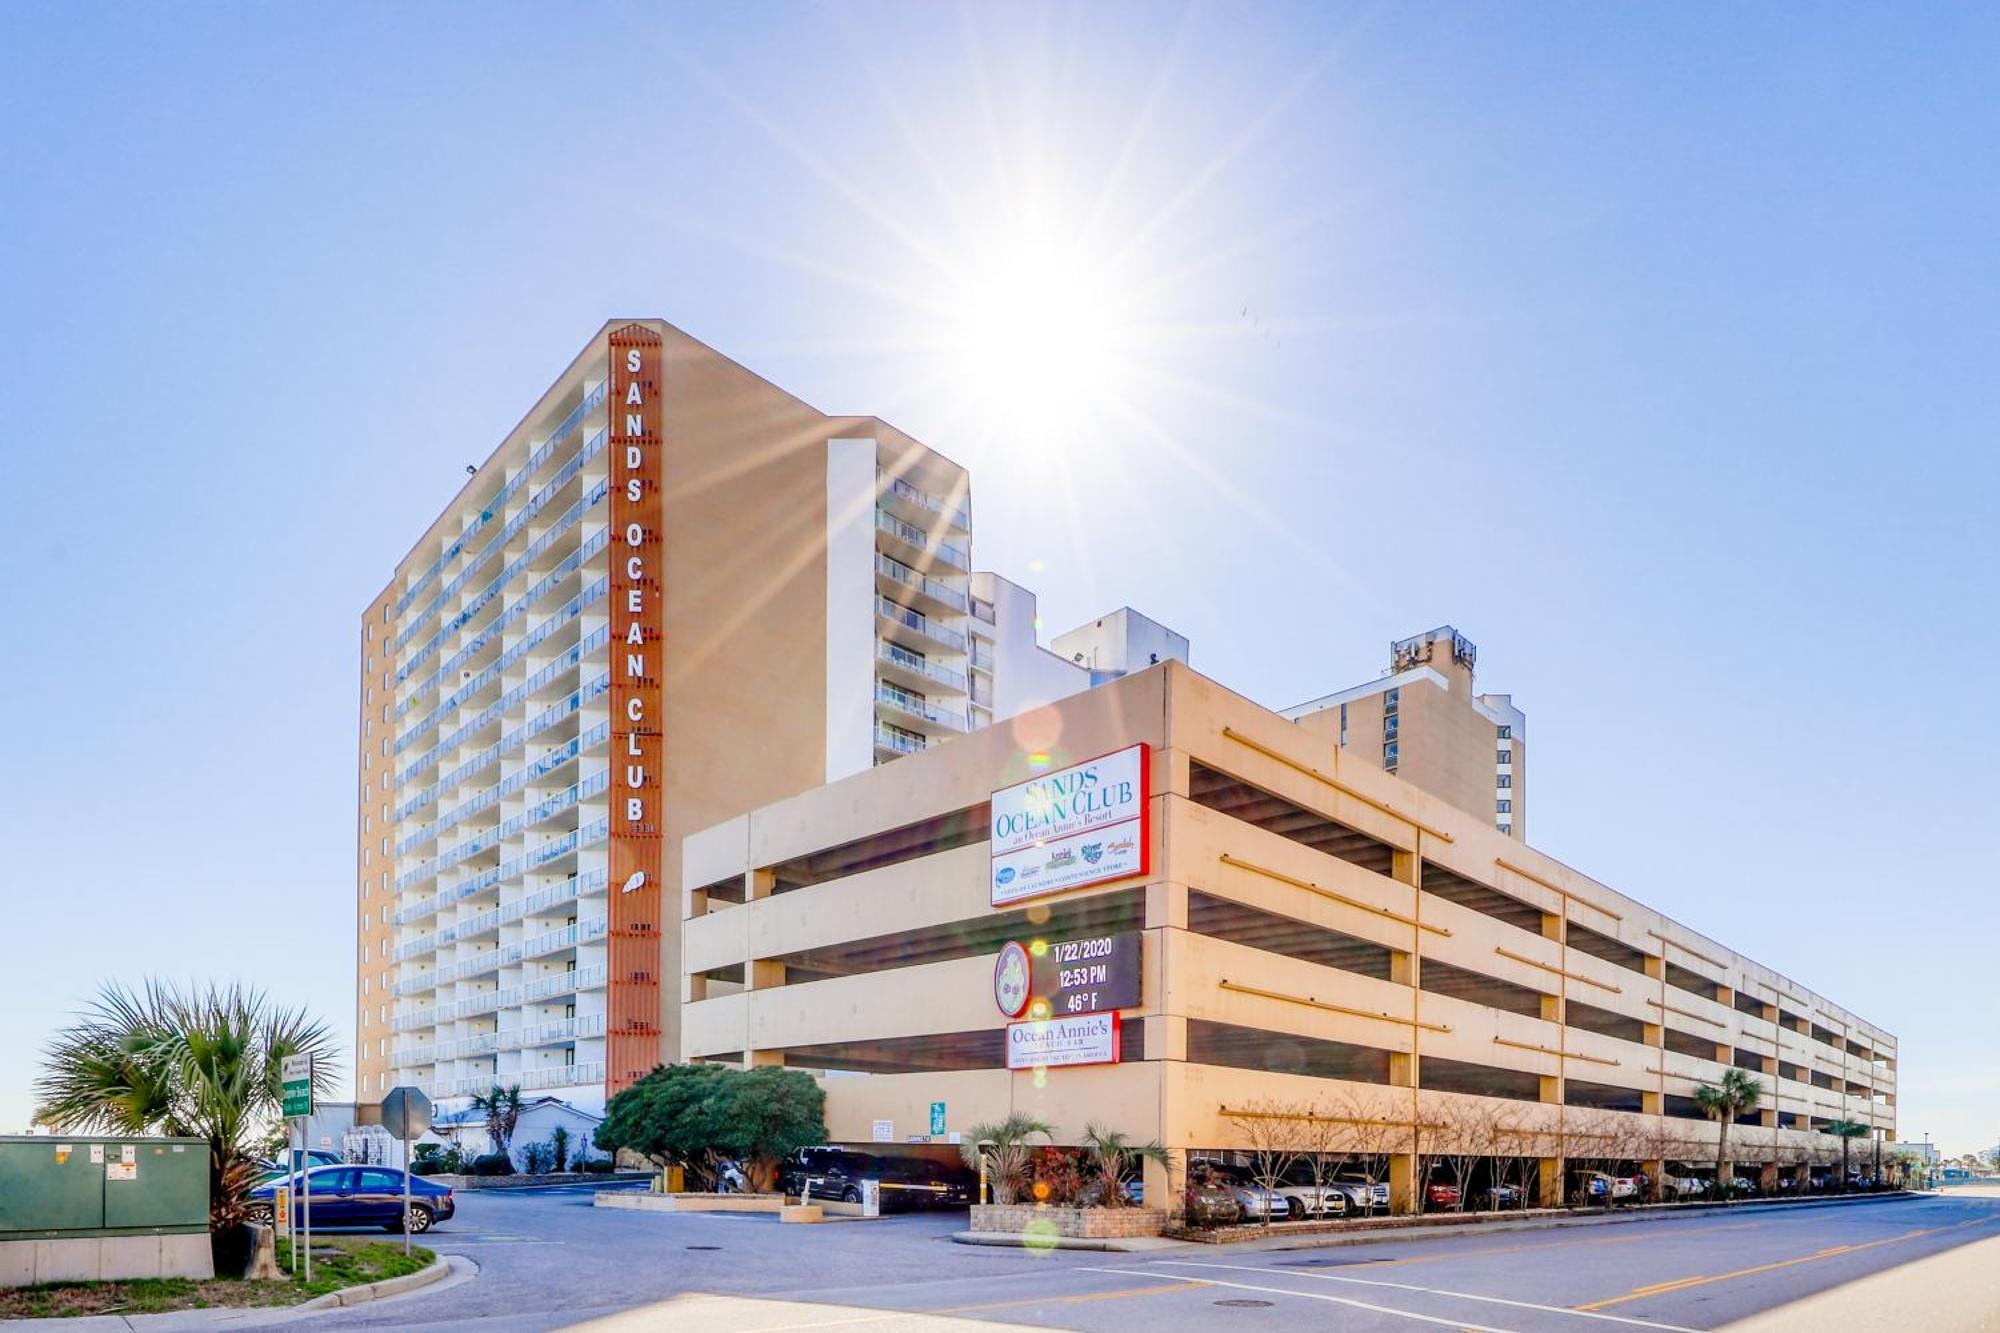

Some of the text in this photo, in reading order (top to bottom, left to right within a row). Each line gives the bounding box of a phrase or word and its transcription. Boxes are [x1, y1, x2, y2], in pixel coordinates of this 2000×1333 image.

[626, 349, 644, 821] SANDS OCEAN CLUB
[1025, 766, 1099, 801] SANDS
[996, 781, 1133, 838] OCEAN CLUB
[1024, 828, 1051, 842] Ocean
[1053, 818, 1082, 833] Annie's
[1084, 809, 1113, 827] Resort
[1054, 937, 1113, 963] 1/22/2020
[1059, 964, 1107, 988] 12:53 PM
[1067, 992, 1098, 1012] 46° F
[1012, 1020, 1108, 1043] Ocean Annie's
